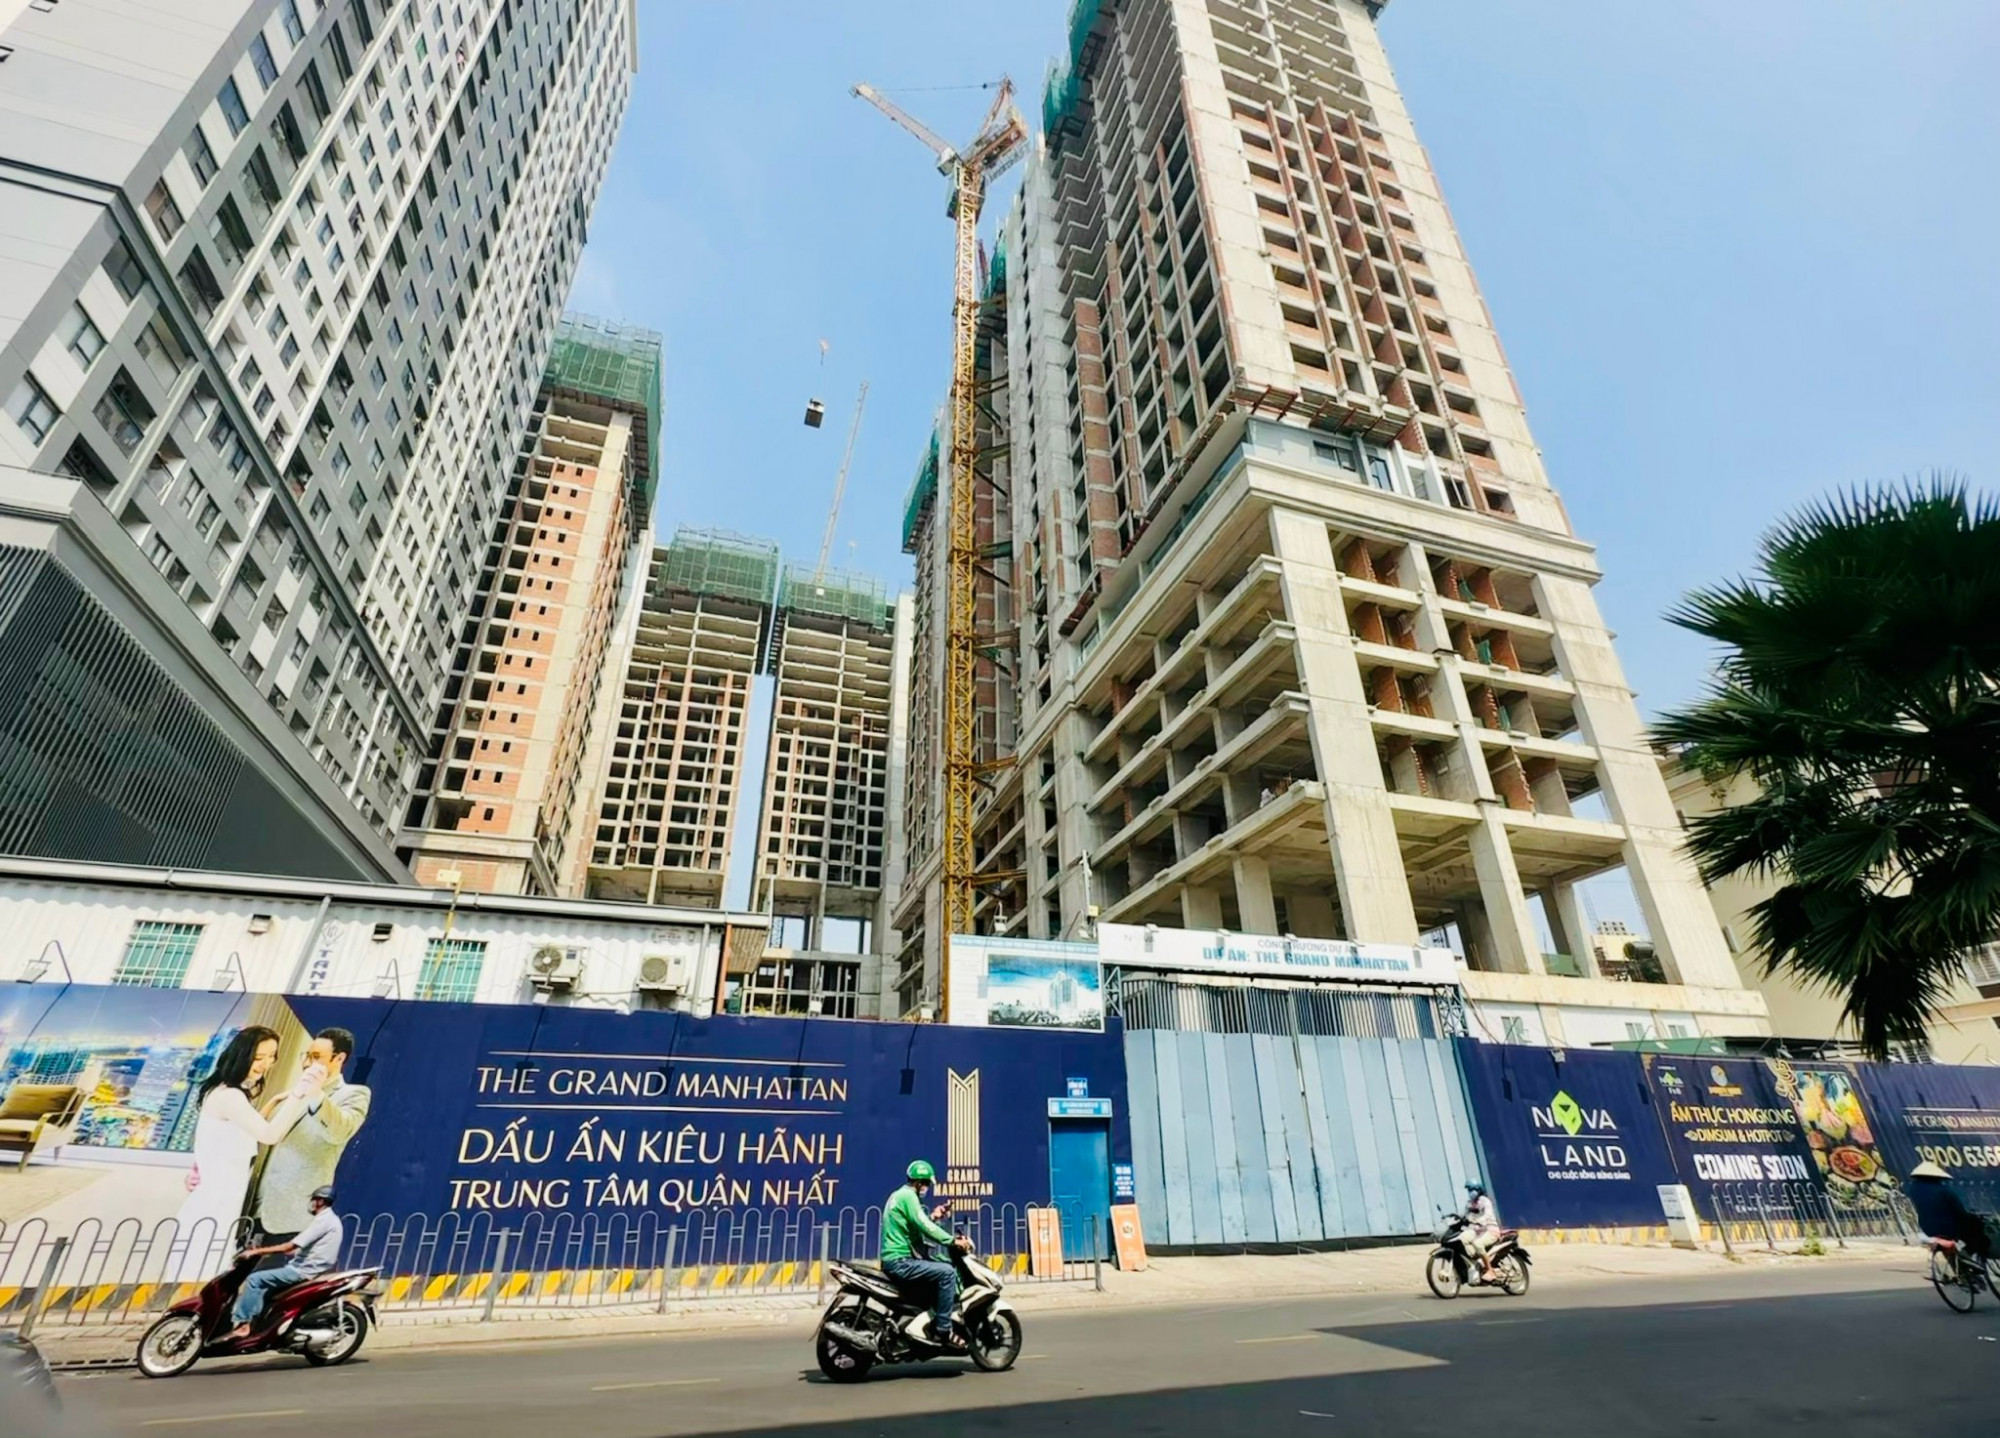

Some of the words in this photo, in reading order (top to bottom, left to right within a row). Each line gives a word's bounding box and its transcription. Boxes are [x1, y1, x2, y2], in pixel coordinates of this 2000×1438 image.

[1255, 951, 1280, 964] THE
[1284, 952, 1330, 967] GRAND
[1334, 955, 1409, 971] MANHATTAN
[477, 1066, 540, 1095] THE
[548, 1068, 667, 1097] GRAND
[675, 1073, 848, 1101] MANHATTAN
[1690, 1105, 1728, 1127] THỰC
[1727, 1107, 1796, 1125] HONGKONG
[1903, 1115, 1922, 1128] THE
[1922, 1115, 1959, 1128] GRAND
[457, 1116, 555, 1165] DẤU
[566, 1116, 625, 1164] ẤN
[637, 1123, 725, 1165] KIÊU
[737, 1126, 843, 1165] HÃNH
[1699, 1128, 1739, 1142] DIMSUM
[1739, 1129, 1748, 1142] &
[1747, 1129, 1783, 1143] HOTPOT
[1541, 1144, 1627, 1167] LAND
[1914, 1145, 1962, 1167] 1900
[947, 1168, 980, 1183] GRAND
[1693, 1154, 1764, 1181] COMING
[1763, 1154, 1810, 1181] SOON
[449, 1178, 571, 1209] TRUNG
[583, 1172, 649, 1207] TÂM
[658, 1172, 751, 1213] QUẬN
[762, 1168, 839, 1207] NHẤT
[933, 1182, 993, 1197] MANHATTAN
